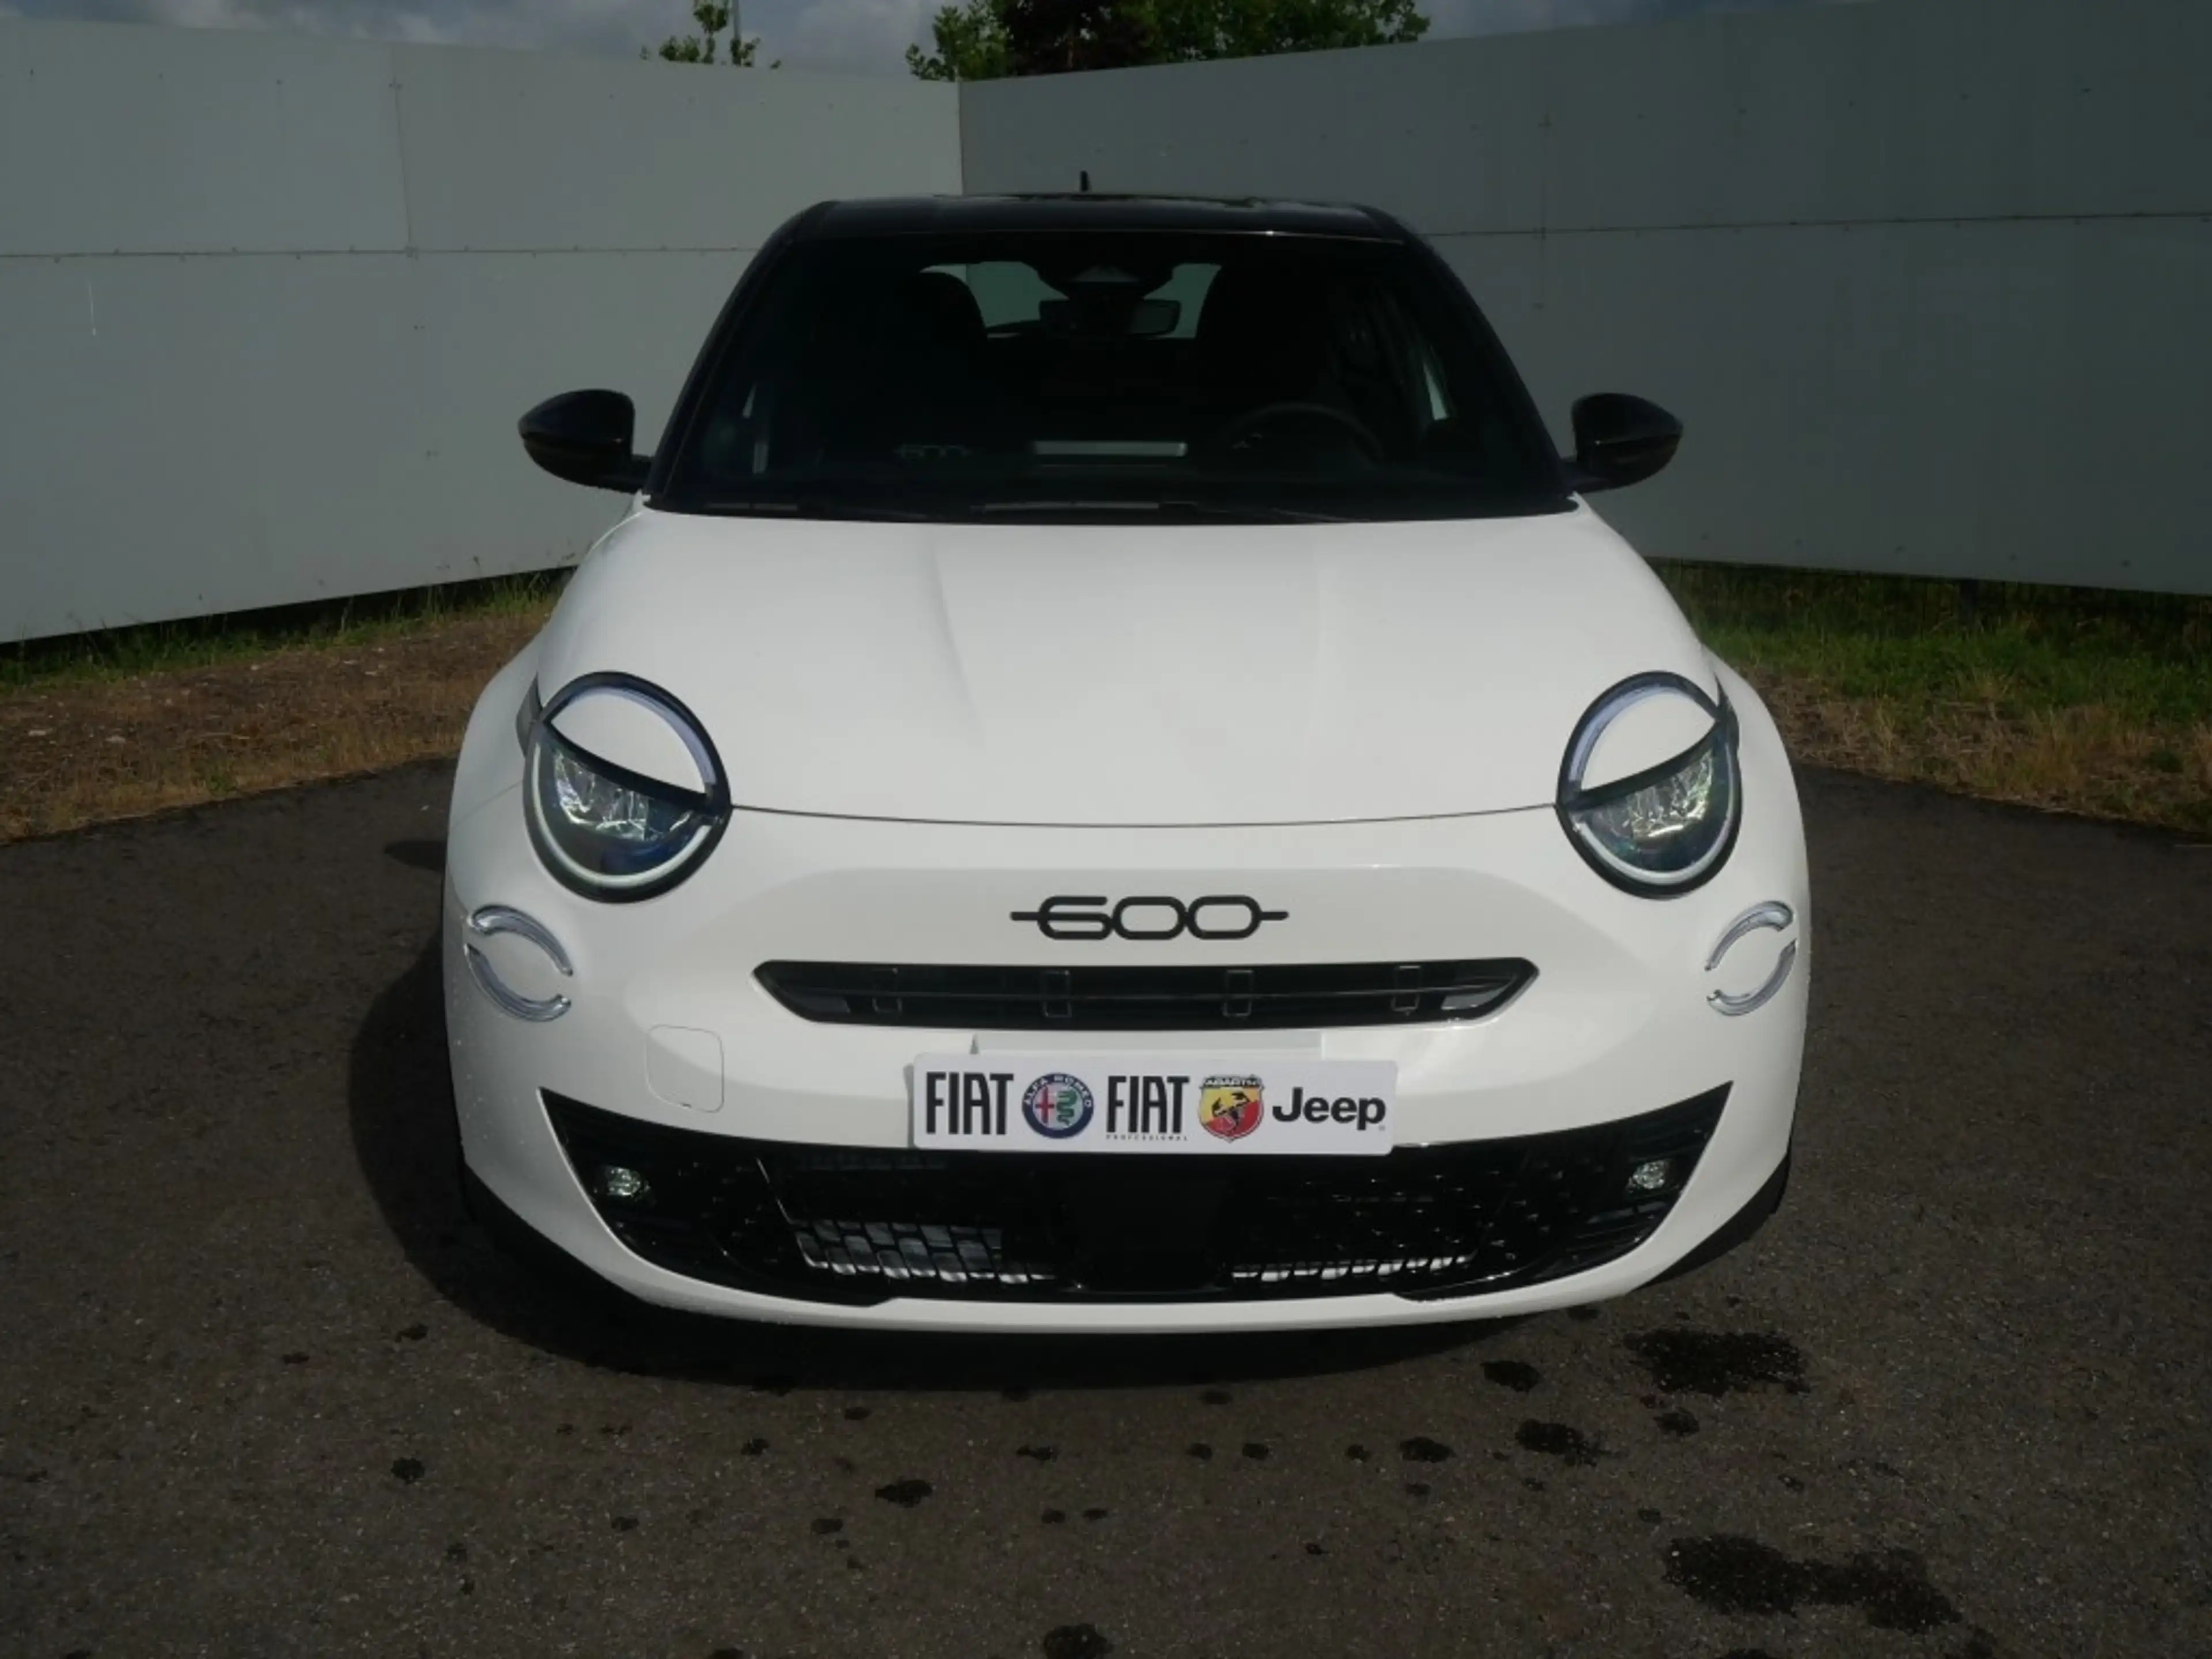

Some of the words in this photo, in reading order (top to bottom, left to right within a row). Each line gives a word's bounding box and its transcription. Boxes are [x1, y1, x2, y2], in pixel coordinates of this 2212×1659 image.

[1037, 895, 1262, 940] 600
[926, 1071, 1014, 1135] FIAT
[1106, 1075, 1190, 1134] FIAT
[1272, 1086, 1387, 1131] Jeep
